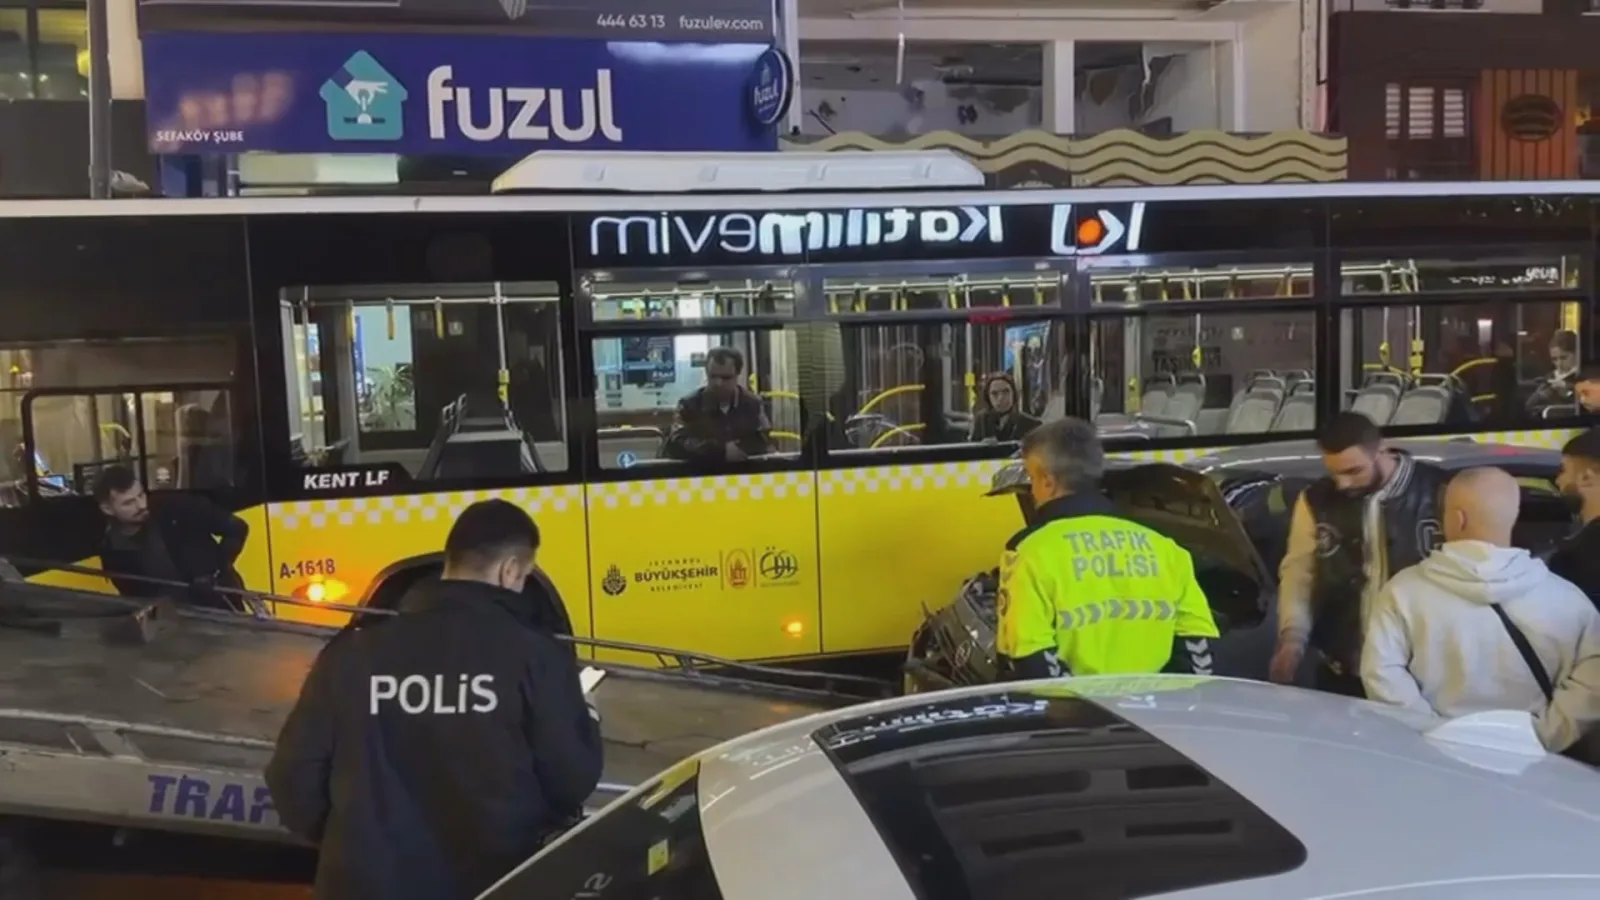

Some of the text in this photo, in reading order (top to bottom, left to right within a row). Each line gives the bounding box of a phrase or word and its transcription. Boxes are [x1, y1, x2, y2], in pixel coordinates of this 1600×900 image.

[597, 14, 666, 28] 444 63 13
[679, 15, 764, 30] fuzulev.com
[427, 65, 623, 142] fuzul
[213, 130, 245, 144] ŞUBE
[303, 470, 390, 490] KENT LF
[280, 559, 335, 580] A-1618
[634, 565, 718, 583] BÜYÜKŞEHİR
